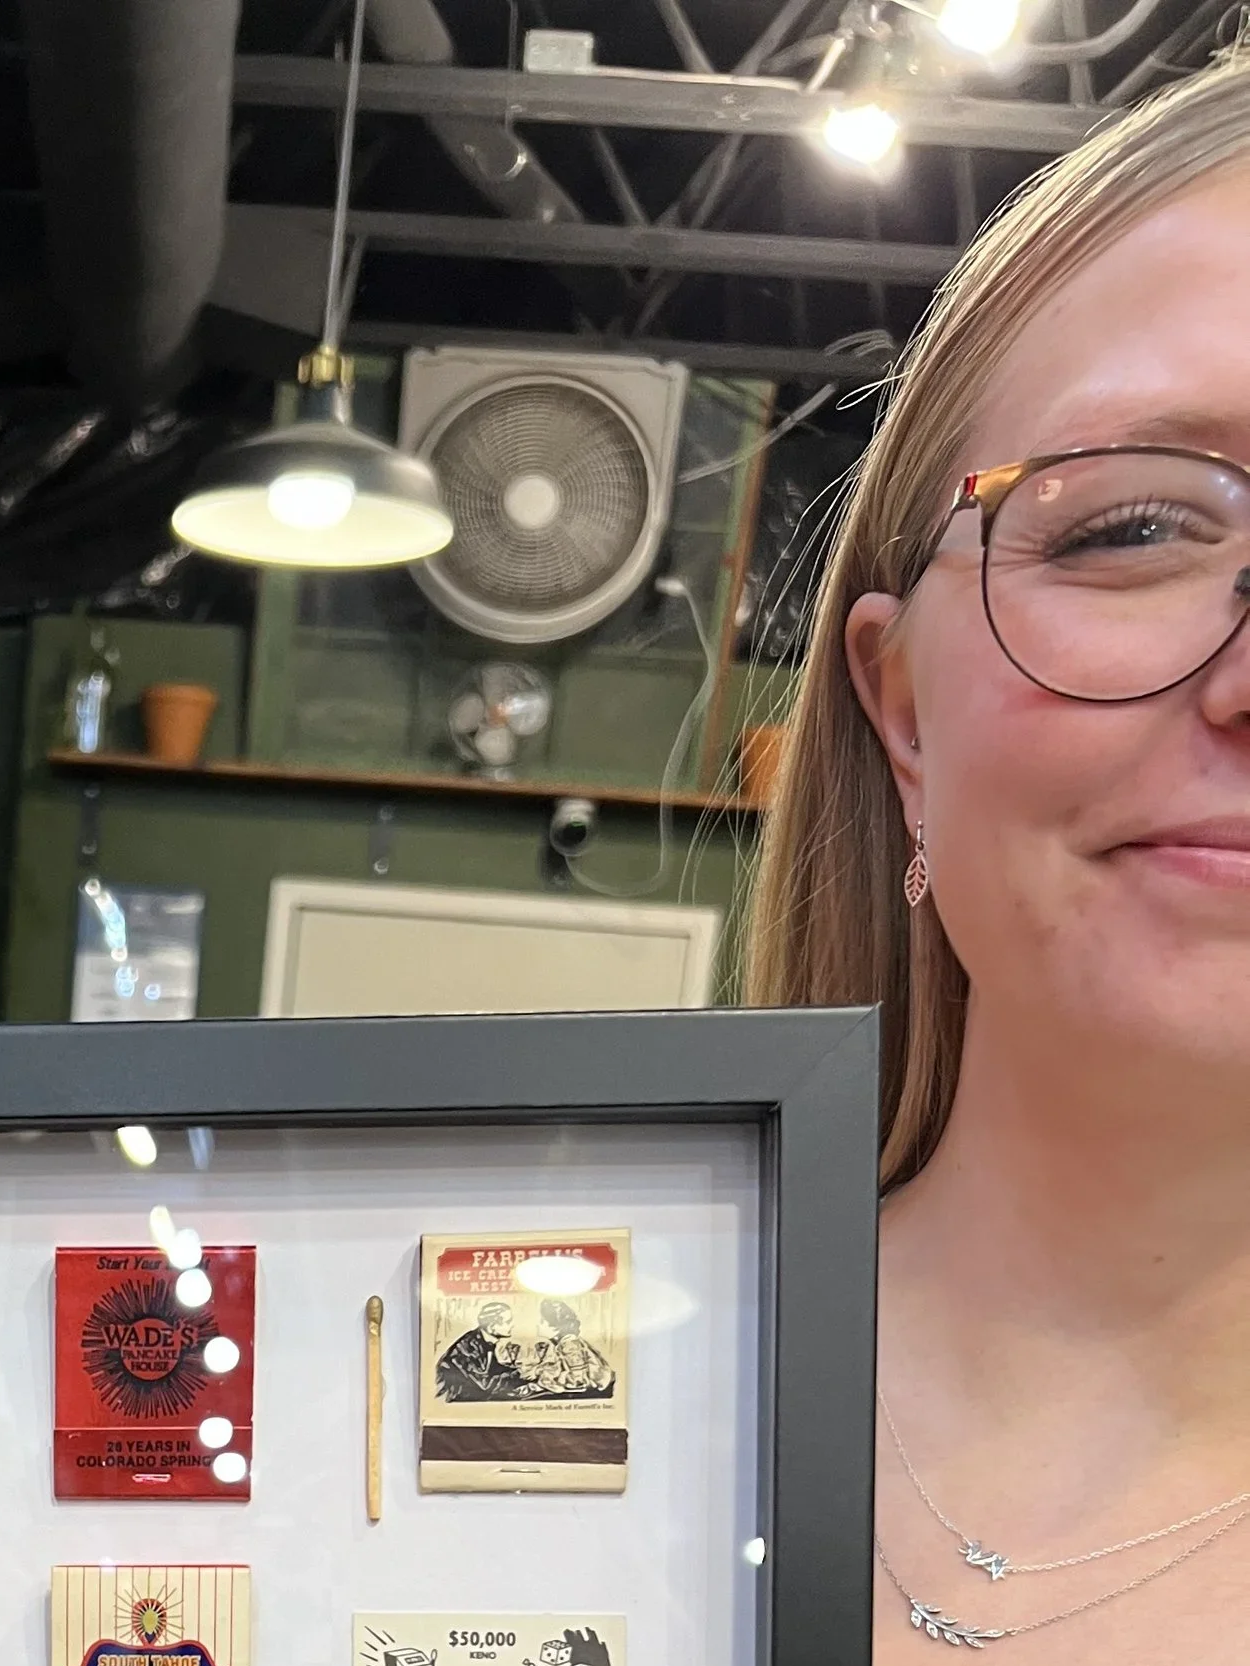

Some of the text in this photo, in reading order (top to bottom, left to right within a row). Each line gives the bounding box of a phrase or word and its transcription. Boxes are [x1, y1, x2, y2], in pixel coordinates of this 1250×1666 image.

[97, 1256, 129, 1270] Start
[134, 1256, 161, 1270] Your
[448, 1270, 471, 1281] ICE
[102, 1322, 197, 1348] WADE'S
[121, 1349, 178, 1360] PANCAKE
[130, 1361, 170, 1372] HOUSE
[127, 1441, 172, 1452] YEARS
[177, 1441, 190, 1451] IN
[76, 1455, 216, 1468] COLORADO SPRING
[449, 1630, 516, 1648] $50,000
[469, 1650, 496, 1660] KENO
